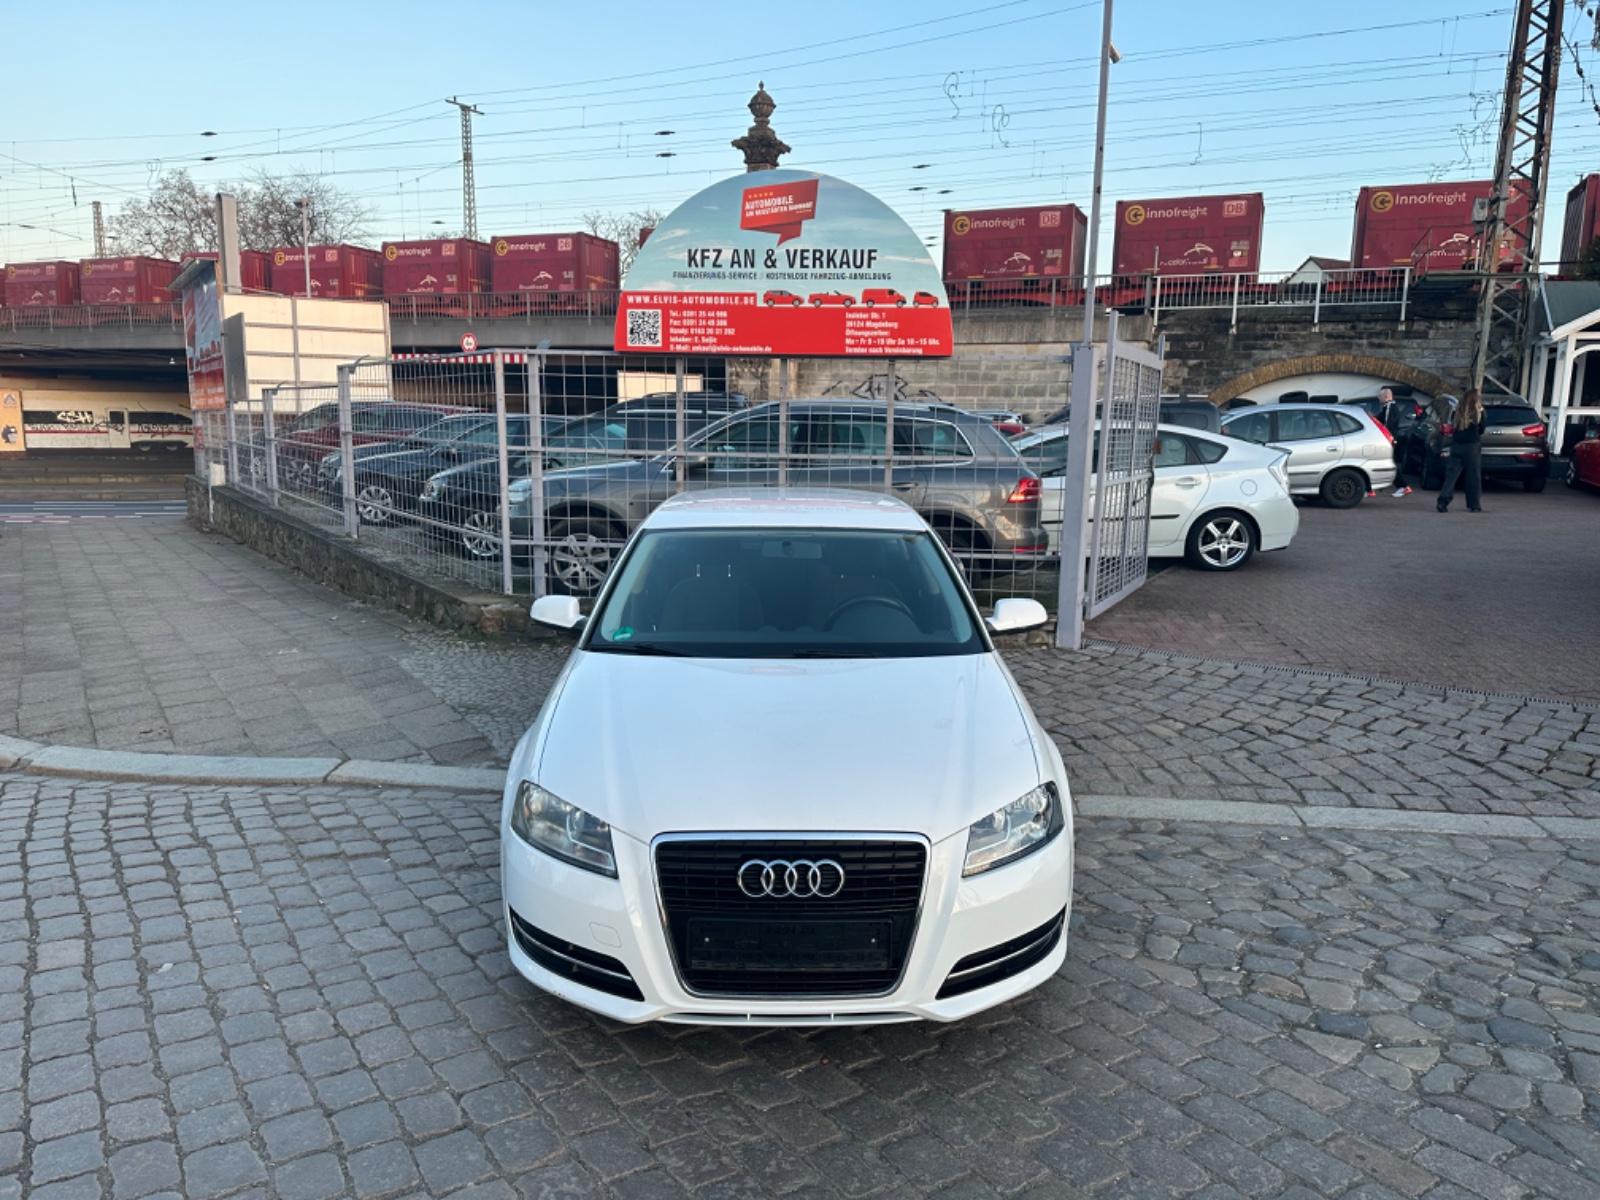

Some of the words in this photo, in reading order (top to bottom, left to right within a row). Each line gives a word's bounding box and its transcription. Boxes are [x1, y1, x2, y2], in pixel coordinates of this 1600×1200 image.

[745, 195, 794, 210] AUTOMOBILE
[1146, 206, 1208, 220] innofreight
[971, 217, 1025, 230] innofreight
[687, 248, 722, 269] KFZ
[730, 248, 755, 269] AN
[764, 248, 777, 269] &
[787, 248, 878, 269] VERKAUF
[766, 272, 808, 280] KOSTENLOSE
[627, 295, 755, 305] WWW.ELVIS-AUTOMOBILE.DE
